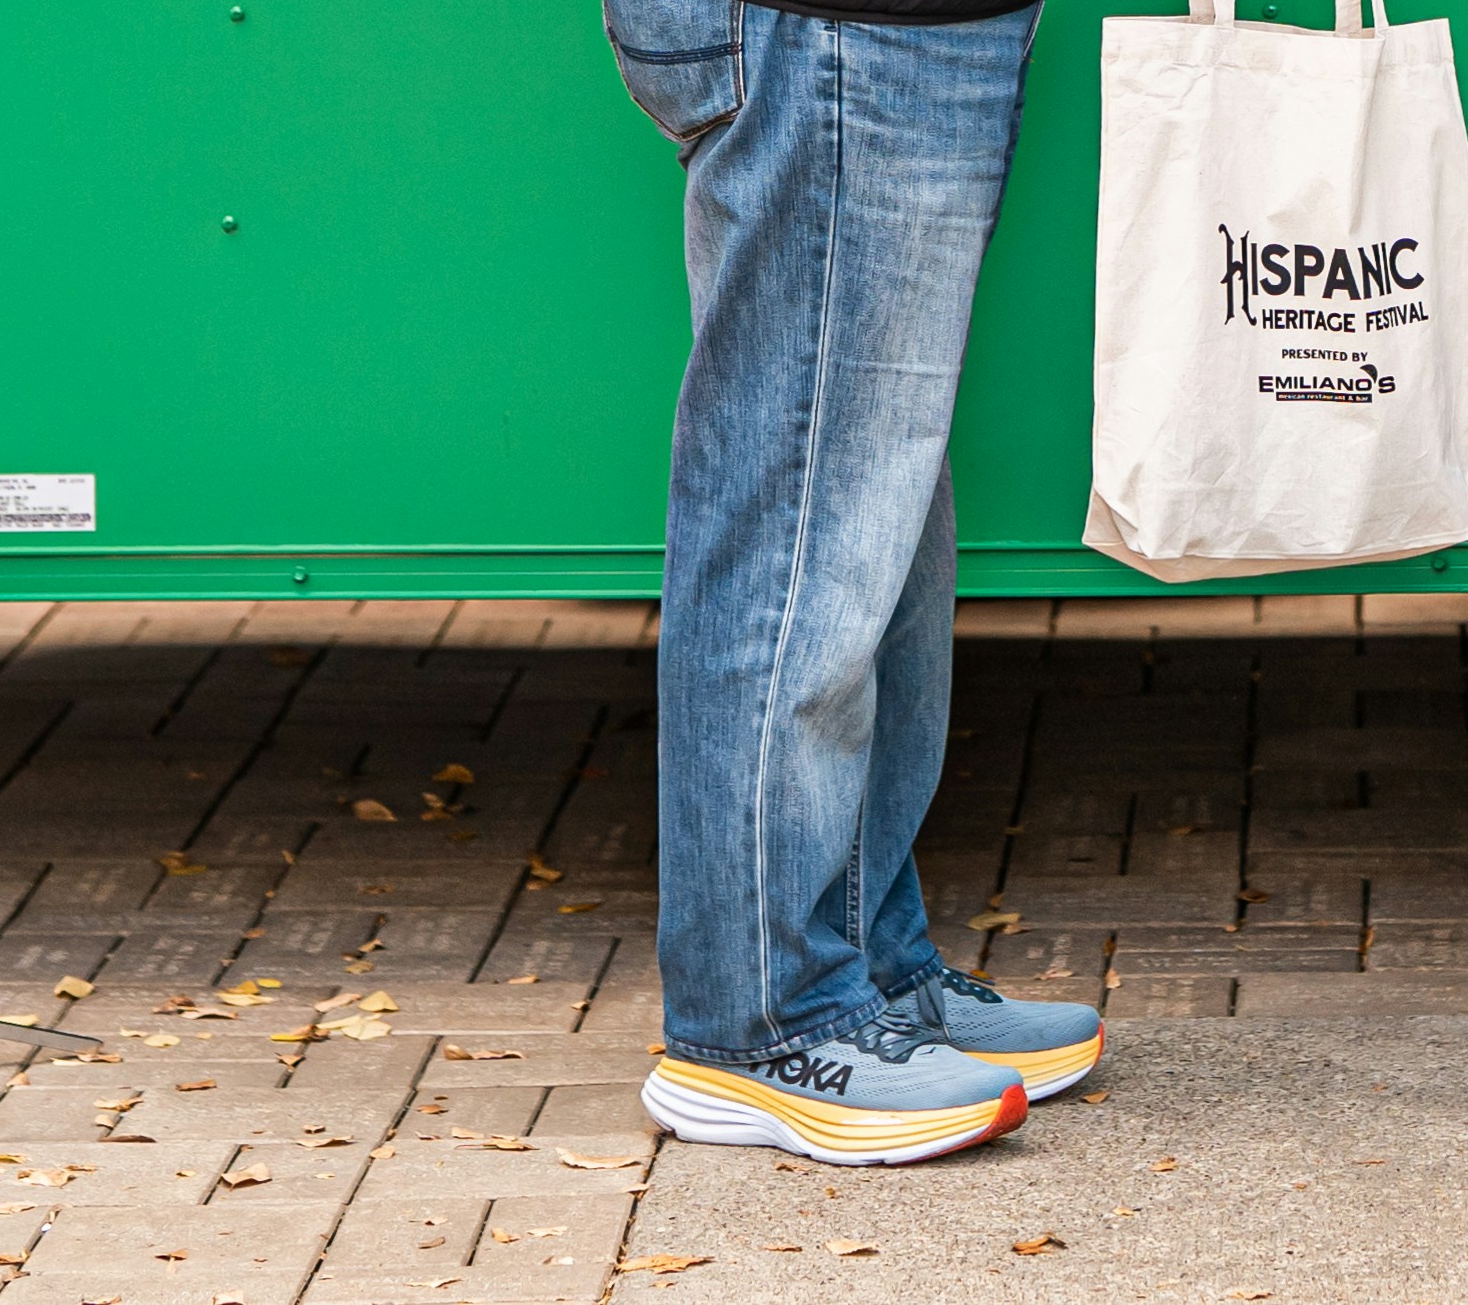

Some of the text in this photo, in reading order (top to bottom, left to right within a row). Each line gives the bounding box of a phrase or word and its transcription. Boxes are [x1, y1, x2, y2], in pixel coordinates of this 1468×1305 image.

[1218, 223, 1425, 326] HISPANIC
[1261, 301, 1430, 333] HERITAGE FESTIVAL
[1281, 348, 1369, 362] PRESENTED BY
